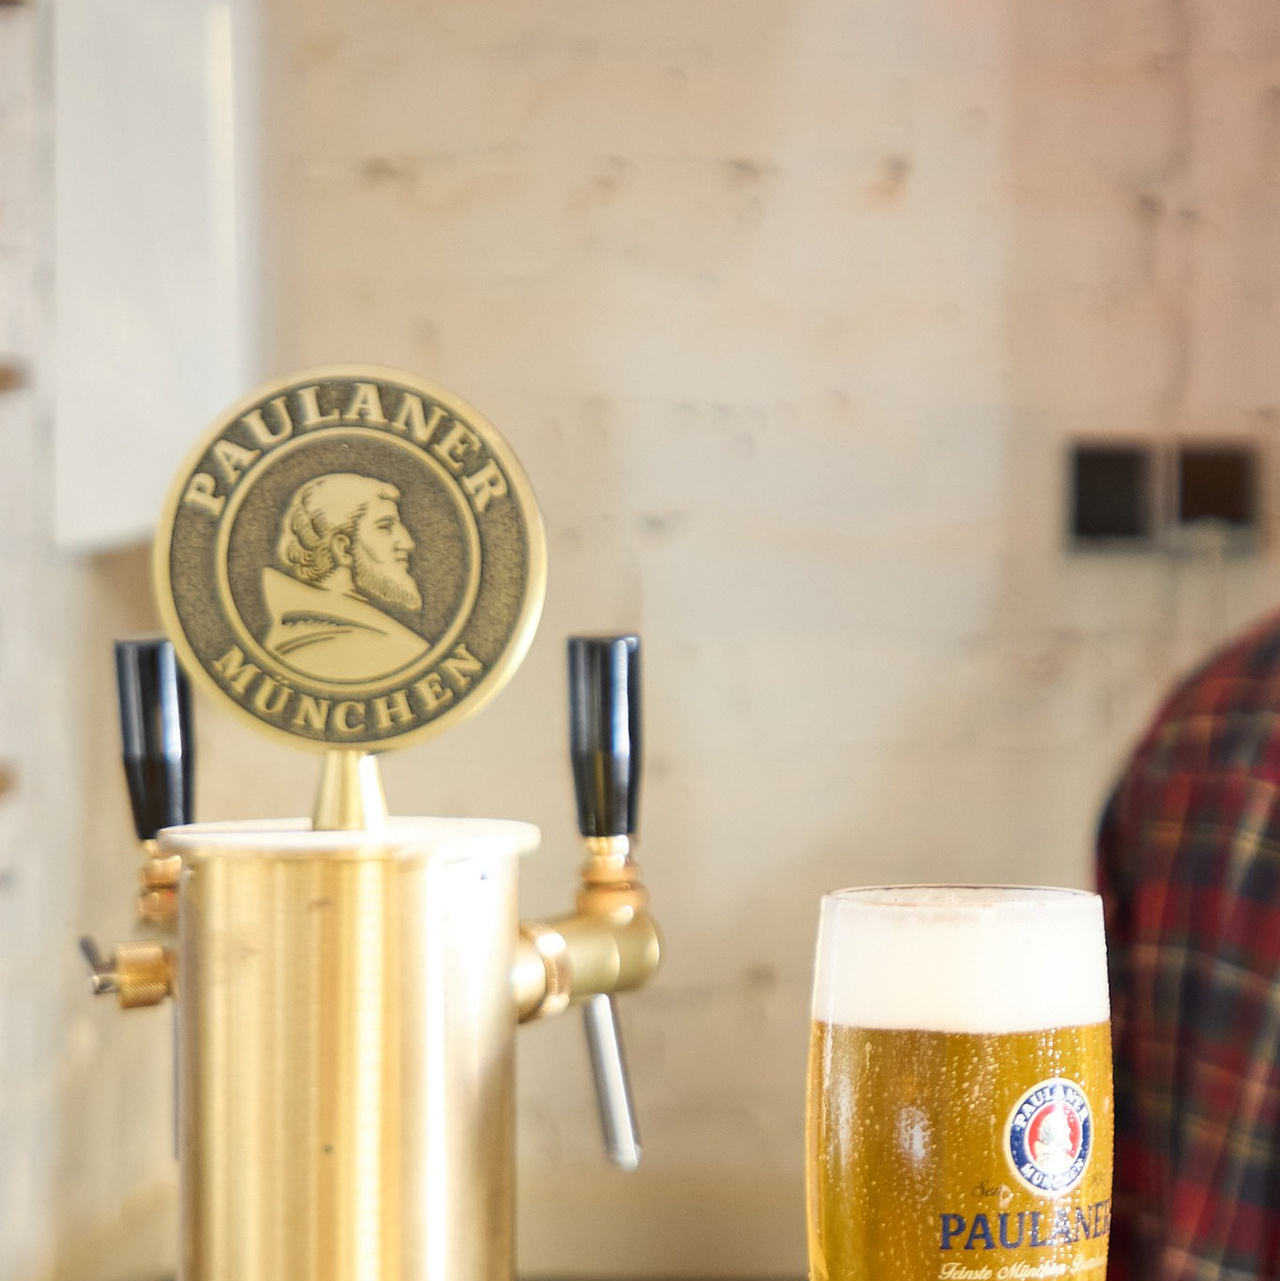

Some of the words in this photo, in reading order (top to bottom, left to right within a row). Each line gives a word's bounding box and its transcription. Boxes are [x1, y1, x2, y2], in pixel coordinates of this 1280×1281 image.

[183, 381, 511, 517] PAULANER
[213, 643, 485, 733] MÜNCHEN
[1013, 1084, 1089, 1128] PAULANER
[938, 1262, 993, 1281] Feinste
